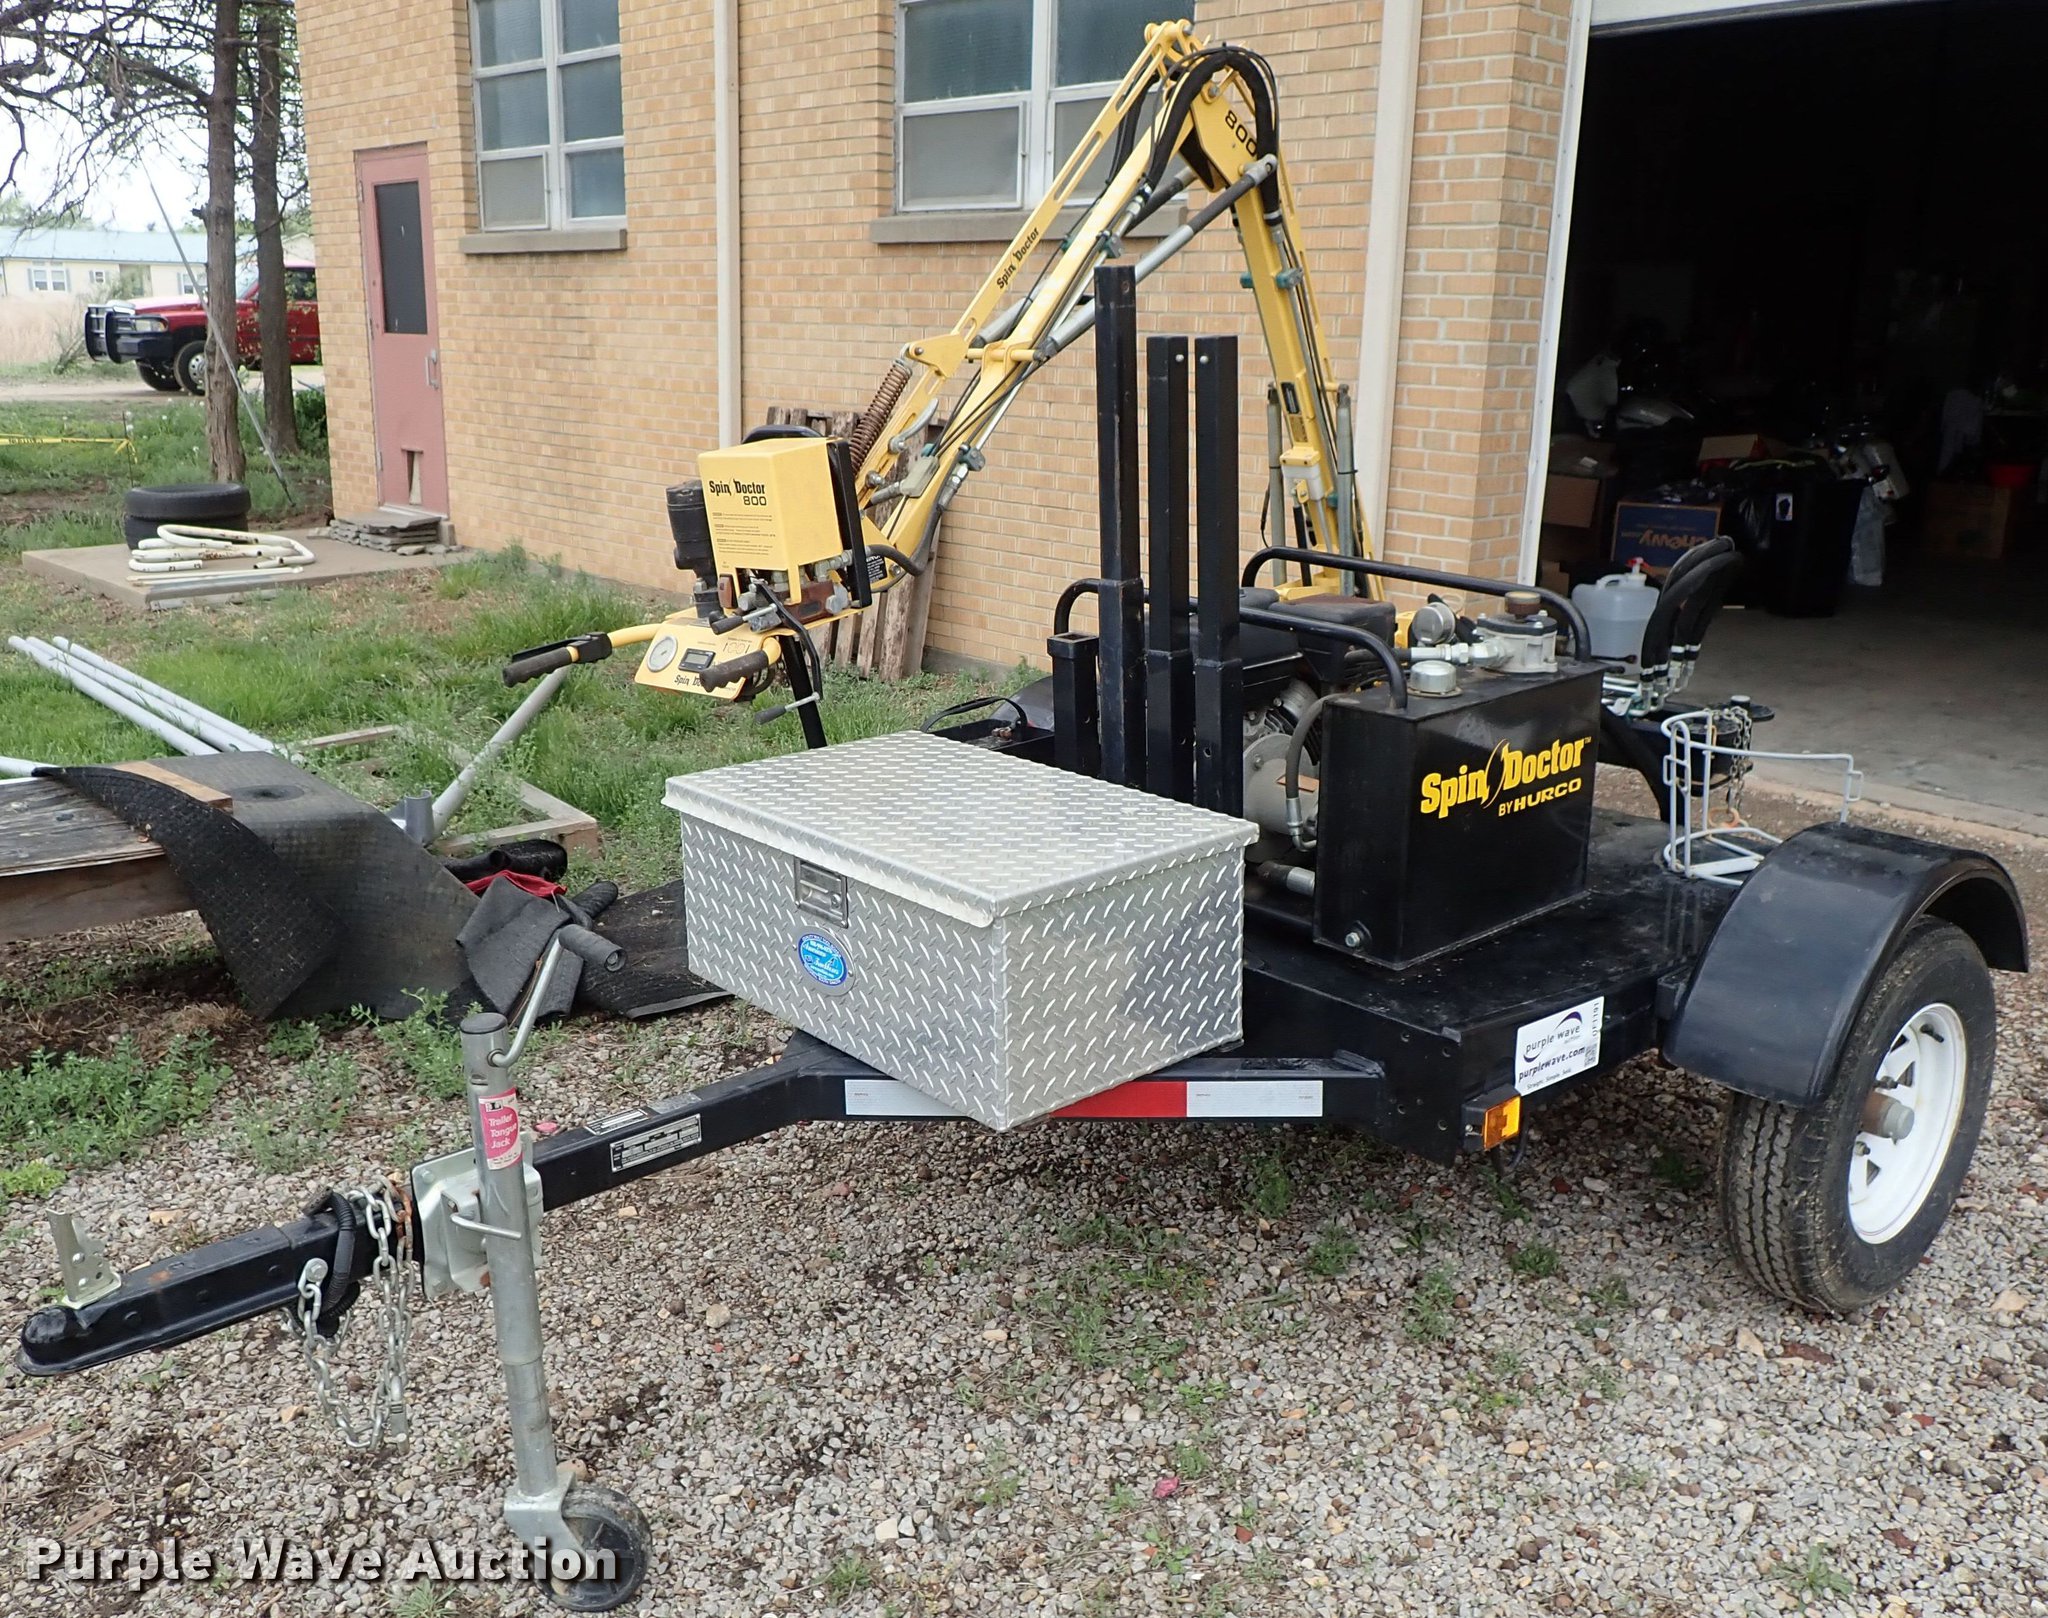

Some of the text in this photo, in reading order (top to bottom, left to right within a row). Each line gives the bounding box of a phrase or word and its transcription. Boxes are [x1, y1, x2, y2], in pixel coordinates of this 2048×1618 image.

[1225, 110, 1257, 157] 800
[997, 228, 1039, 288] Spin Doctor
[709, 478, 765, 497] Spin Doctor
[743, 496, 767, 506] 800
[674, 674, 690, 687] Spin
[1420, 764, 1491, 819] Spin
[1498, 777, 1582, 817] BY HURCO
[1526, 1025, 1580, 1054] purple wave
[1519, 1046, 1585, 1082] purplewave.com
[491, 1137, 510, 1149] Jack
